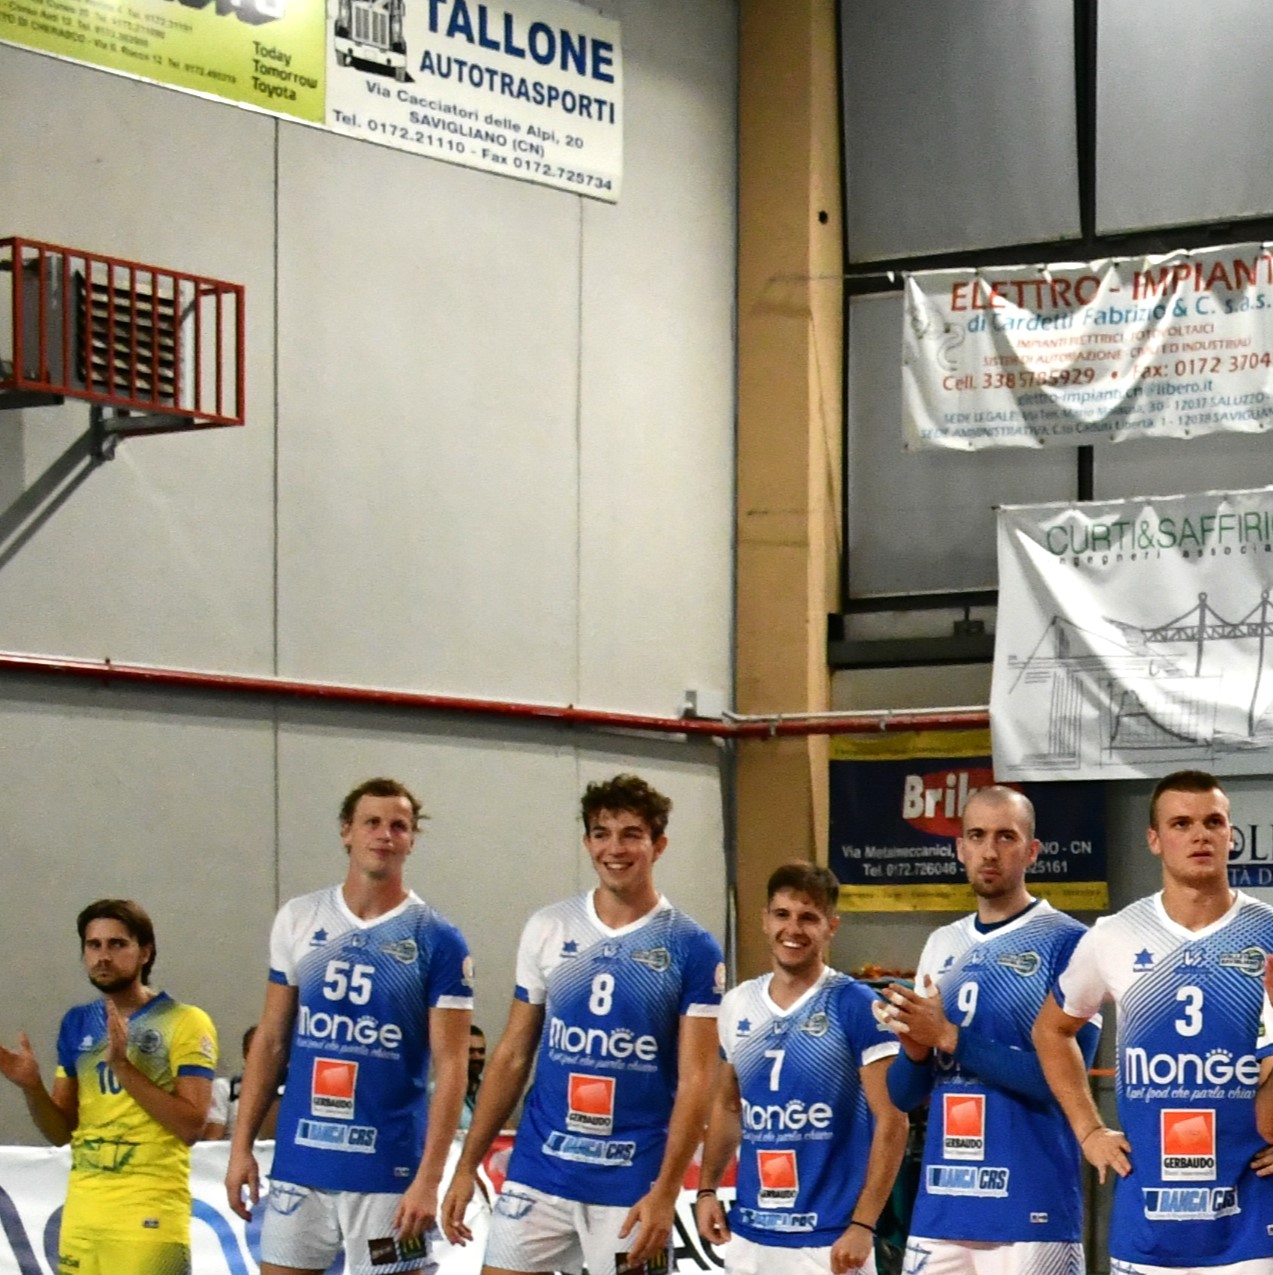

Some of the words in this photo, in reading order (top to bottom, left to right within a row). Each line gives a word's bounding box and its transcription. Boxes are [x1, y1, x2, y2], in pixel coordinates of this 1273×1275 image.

[252, 40, 292, 66] Today
[428, 0, 614, 83] TALLONE
[252, 59, 318, 89] Tomorrow
[252, 76, 296, 101] Toyota
[420, 50, 615, 124] AUTOTRASPORTI
[366, 80, 391, 98] Via
[397, 90, 479, 121] Cacciatori
[484, 112, 521, 132] delle
[565, 134, 584, 149] 20
[409, 110, 507, 147] SAVIGLIANO
[512, 137, 545, 158] (CN)
[332, 109, 361, 128] Tel.
[368, 118, 465, 154] 0172.21110
[482, 147, 508, 165] Fax
[951, 275, 1100, 312] ELETTRO
[968, 315, 985, 333] di
[1083, 303, 1166, 326] Fabrizio
[1173, 298, 1188, 316] &
[1196, 296, 1215, 315] C.
[943, 376, 976, 391] Cell.
[1175, 357, 1220, 376] 0172
[842, 845, 860, 858] Via
[322, 960, 375, 1005] 55
[589, 973, 615, 1016] 8
[957, 982, 979, 1027] 9
[1175, 985, 1204, 1037] 3
[764, 1050, 785, 1091] 7
[979, 1168, 1007, 1190] CRS
[1164, 1157, 1214, 1169] GERBAUDO
